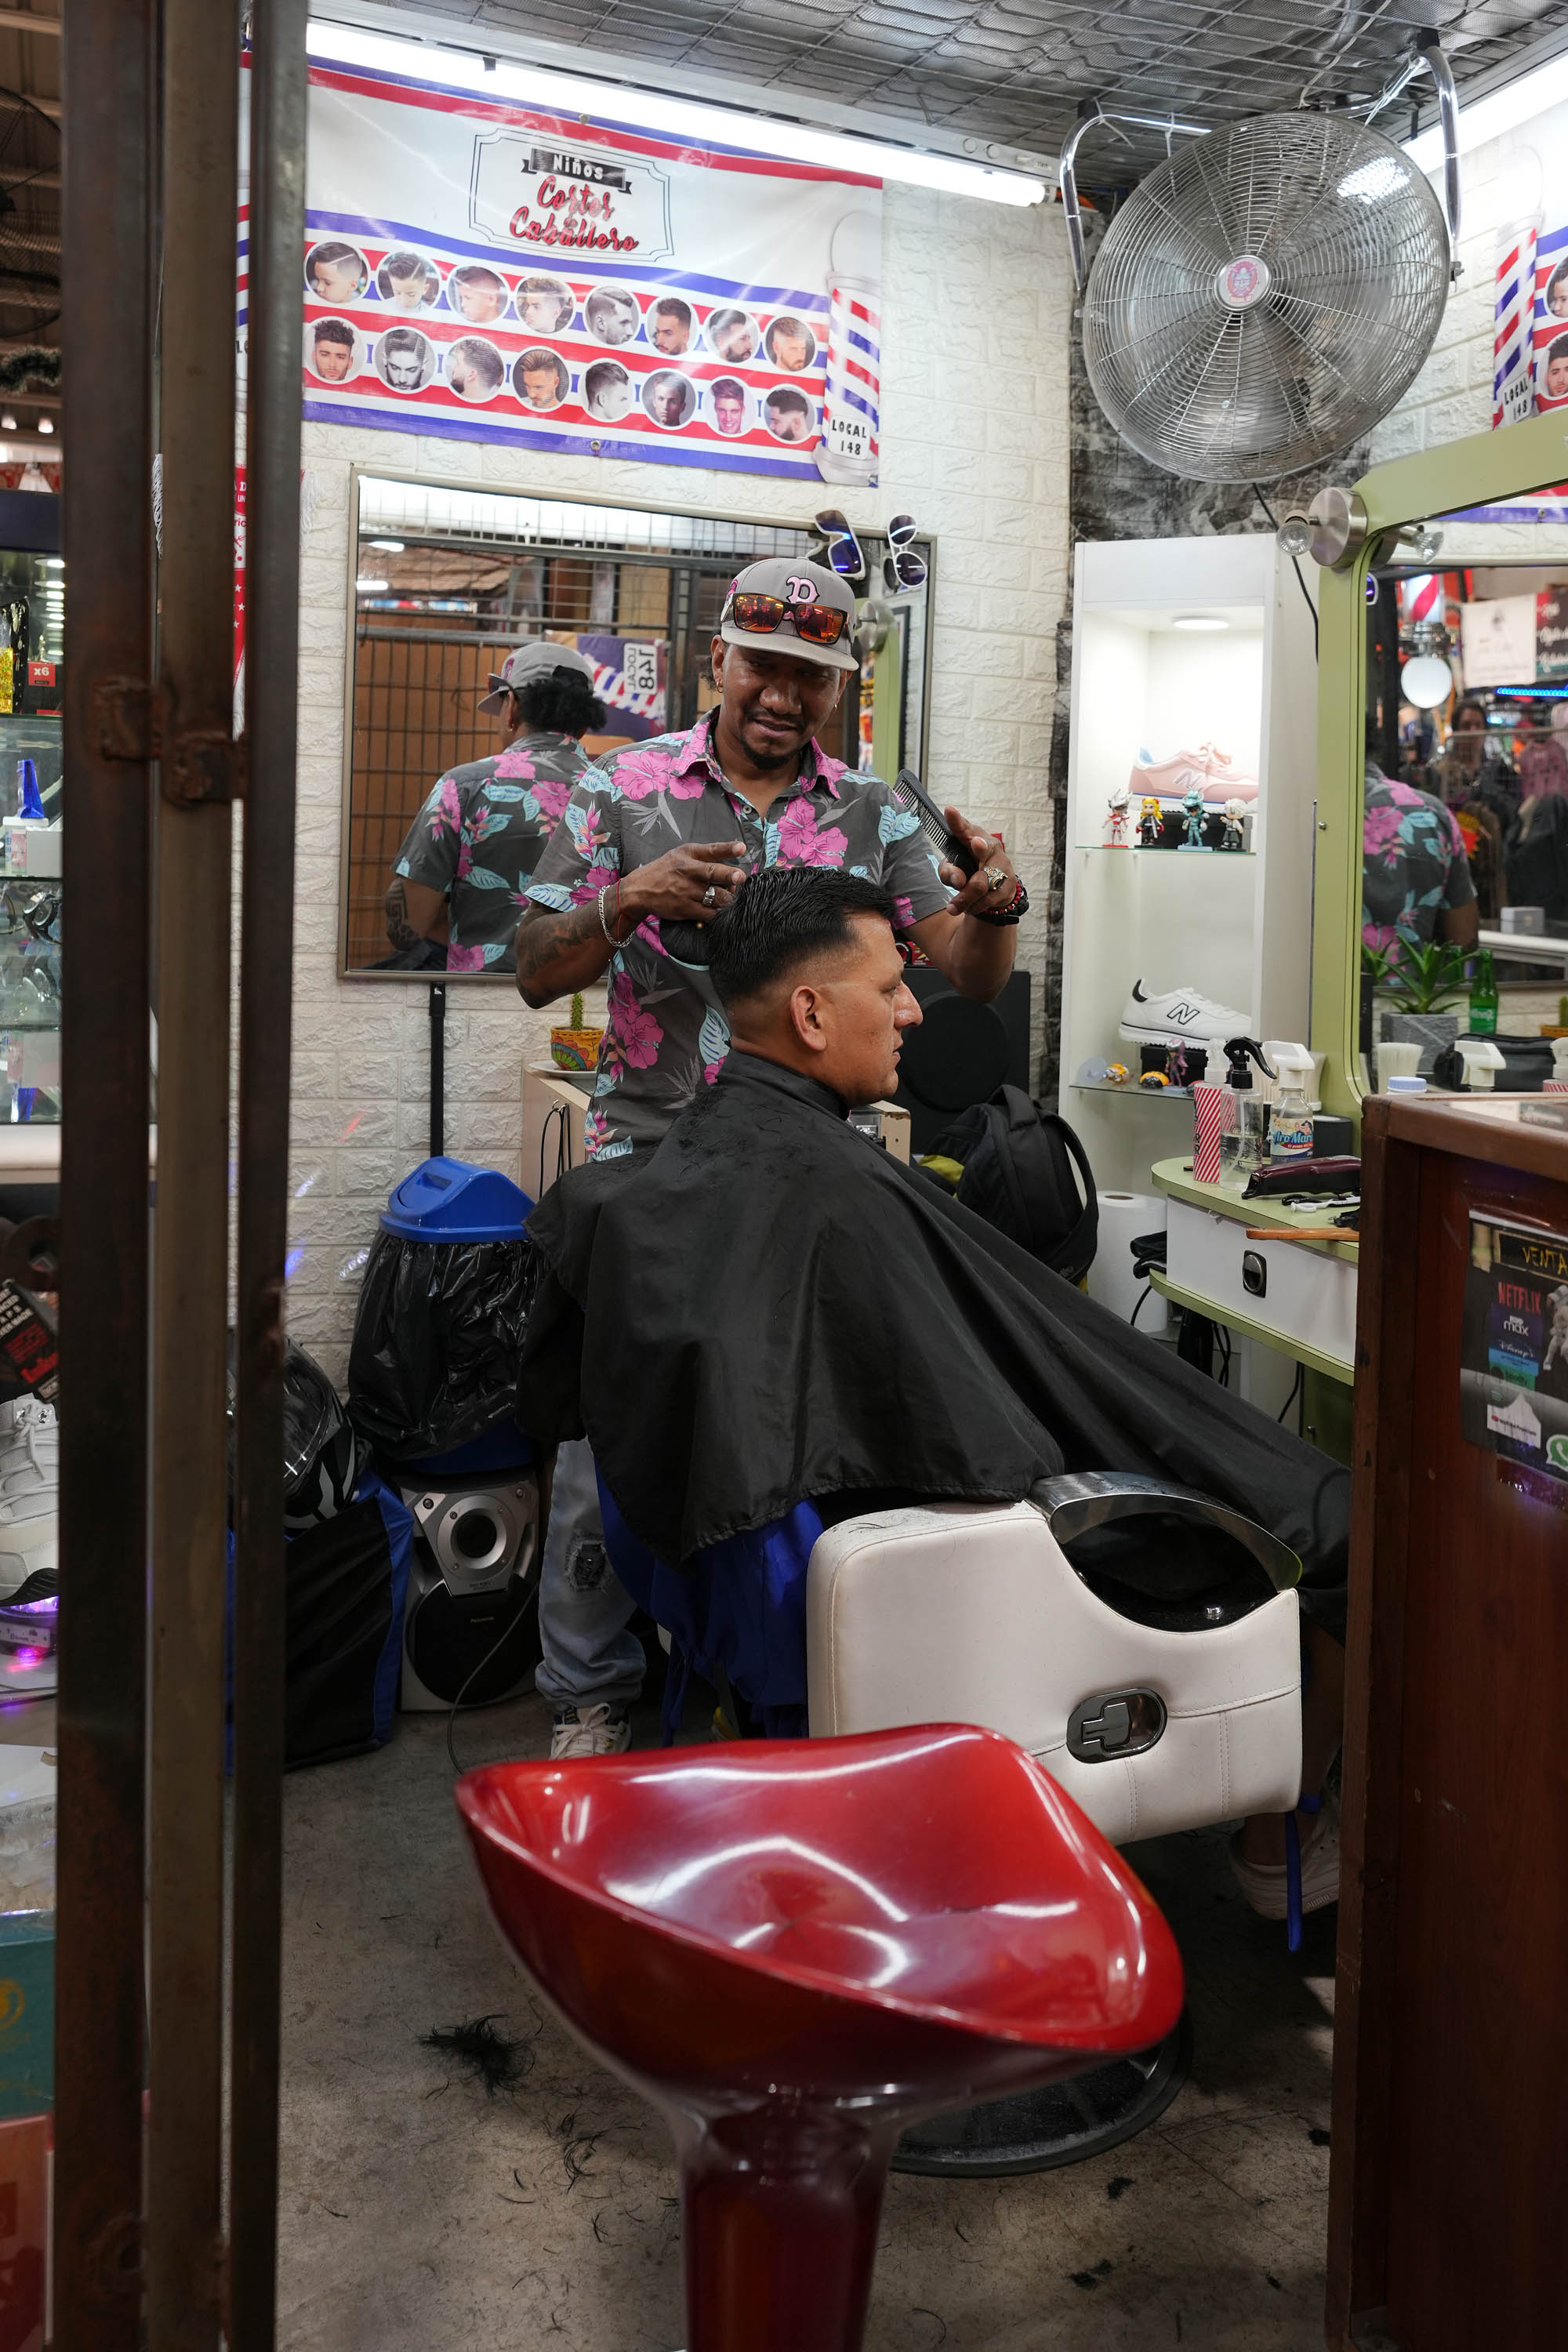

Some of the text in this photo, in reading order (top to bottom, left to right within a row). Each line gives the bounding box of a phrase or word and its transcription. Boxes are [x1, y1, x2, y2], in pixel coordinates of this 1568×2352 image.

[553, 154, 604, 180] Niños
[537, 175, 615, 221] Cortes
[510, 206, 639, 251] Caballero
[1504, 377, 1528, 405] LOCAL
[1513, 399, 1527, 421] 148
[832, 418, 866, 438] LOCAL
[840, 440, 861, 456] 148
[34, 666, 49, 676] x6
[1522, 1246, 1568, 1275] VENTA
[1498, 1282, 1541, 1315] NETFLIX
[1503, 1320, 1528, 1336] max
